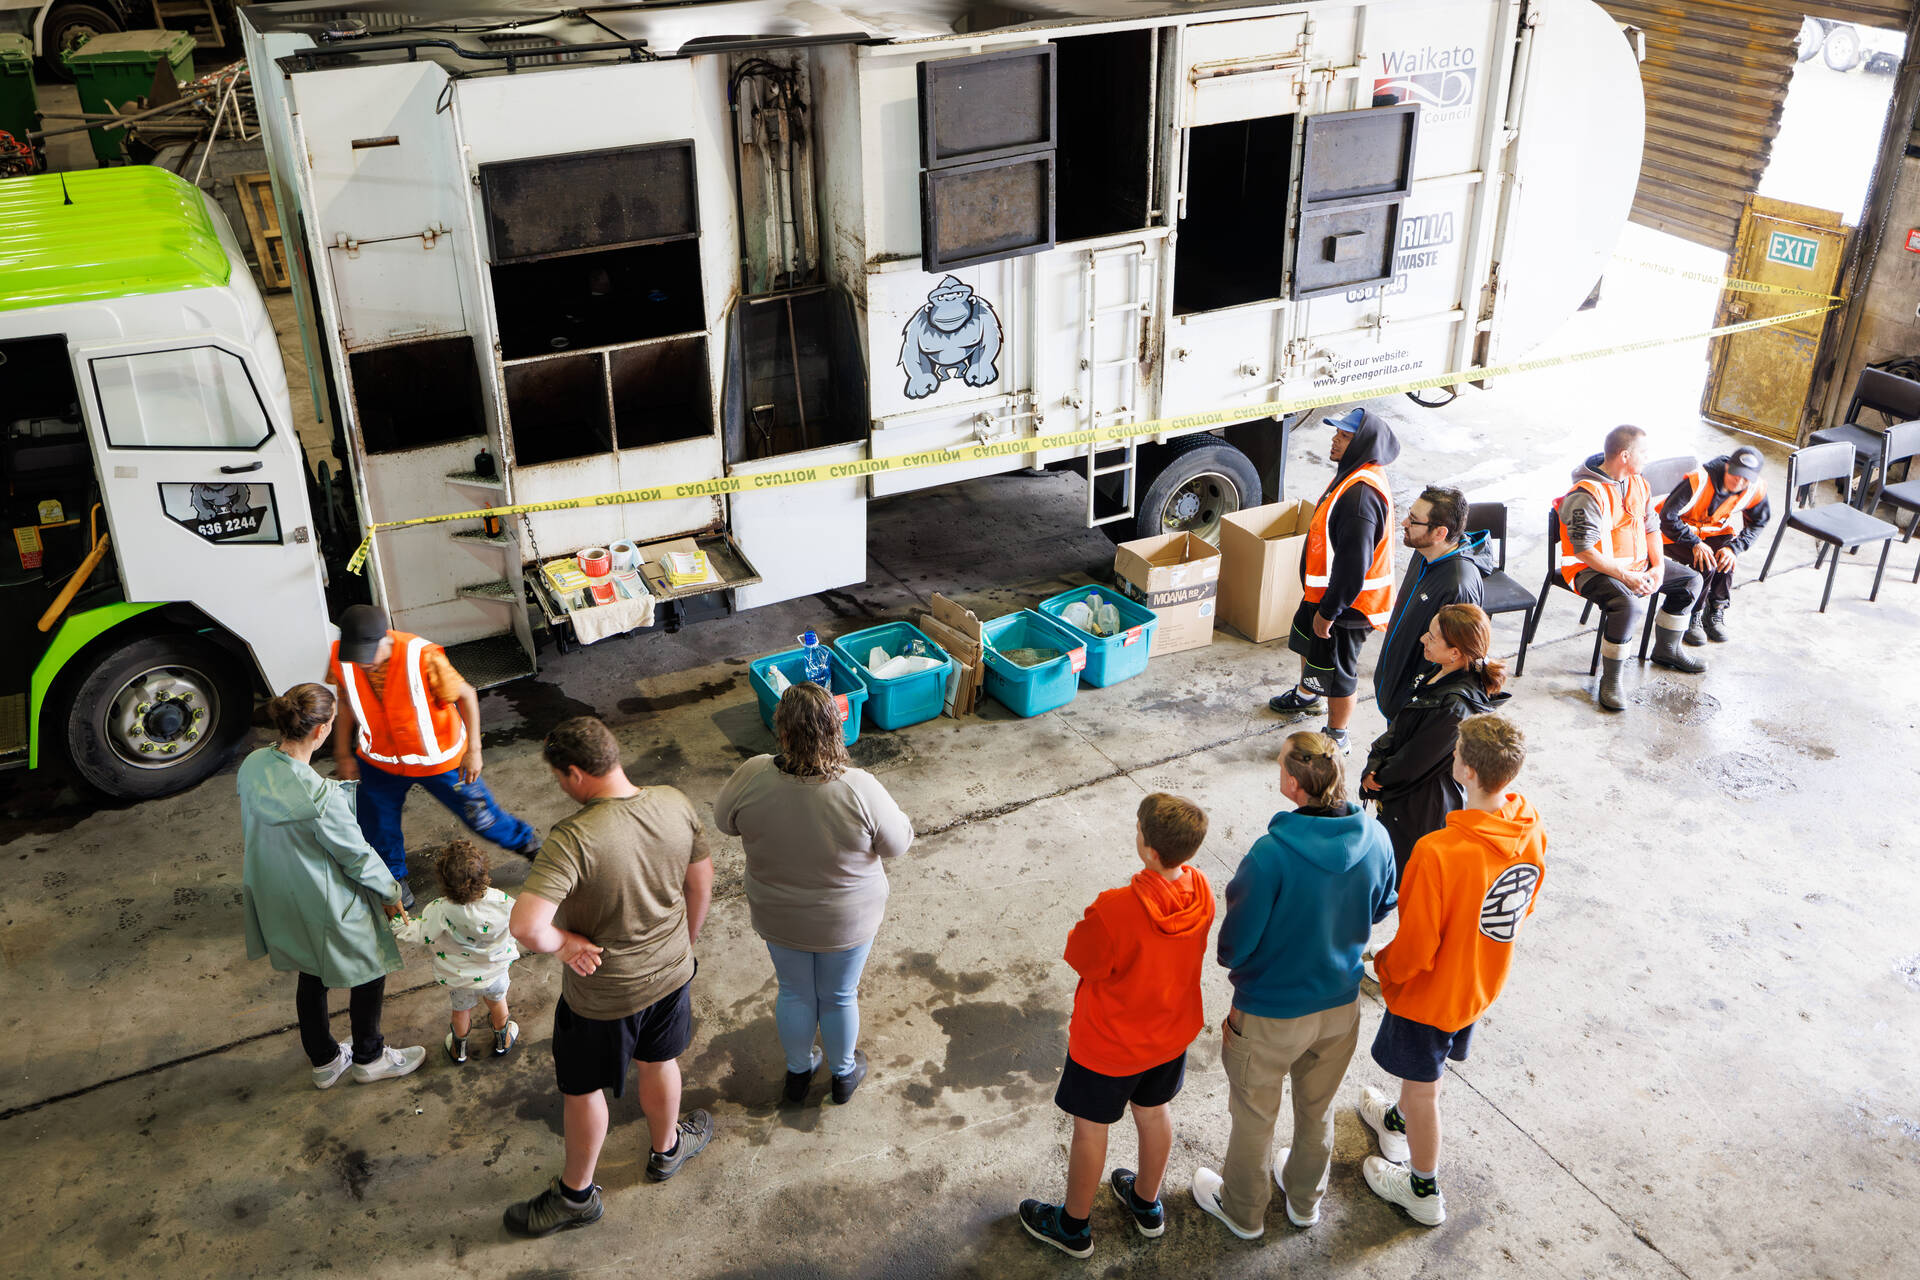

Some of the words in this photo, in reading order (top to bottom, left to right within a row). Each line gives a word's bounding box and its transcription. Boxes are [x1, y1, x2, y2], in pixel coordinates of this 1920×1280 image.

[1382, 46, 1474, 74] Waikato
[1425, 107, 1471, 124] Council
[1770, 235, 1815, 264] EXIT
[1397, 251, 1438, 270] WASTE
[1354, 357, 1370, 367] our
[1371, 349, 1409, 364] website:
[1313, 361, 1423, 388] www.greengorilla.co.nz
[198, 522, 222, 536] 636
[225, 516, 257, 532] 2244
[1153, 589, 1187, 606] MOANA
